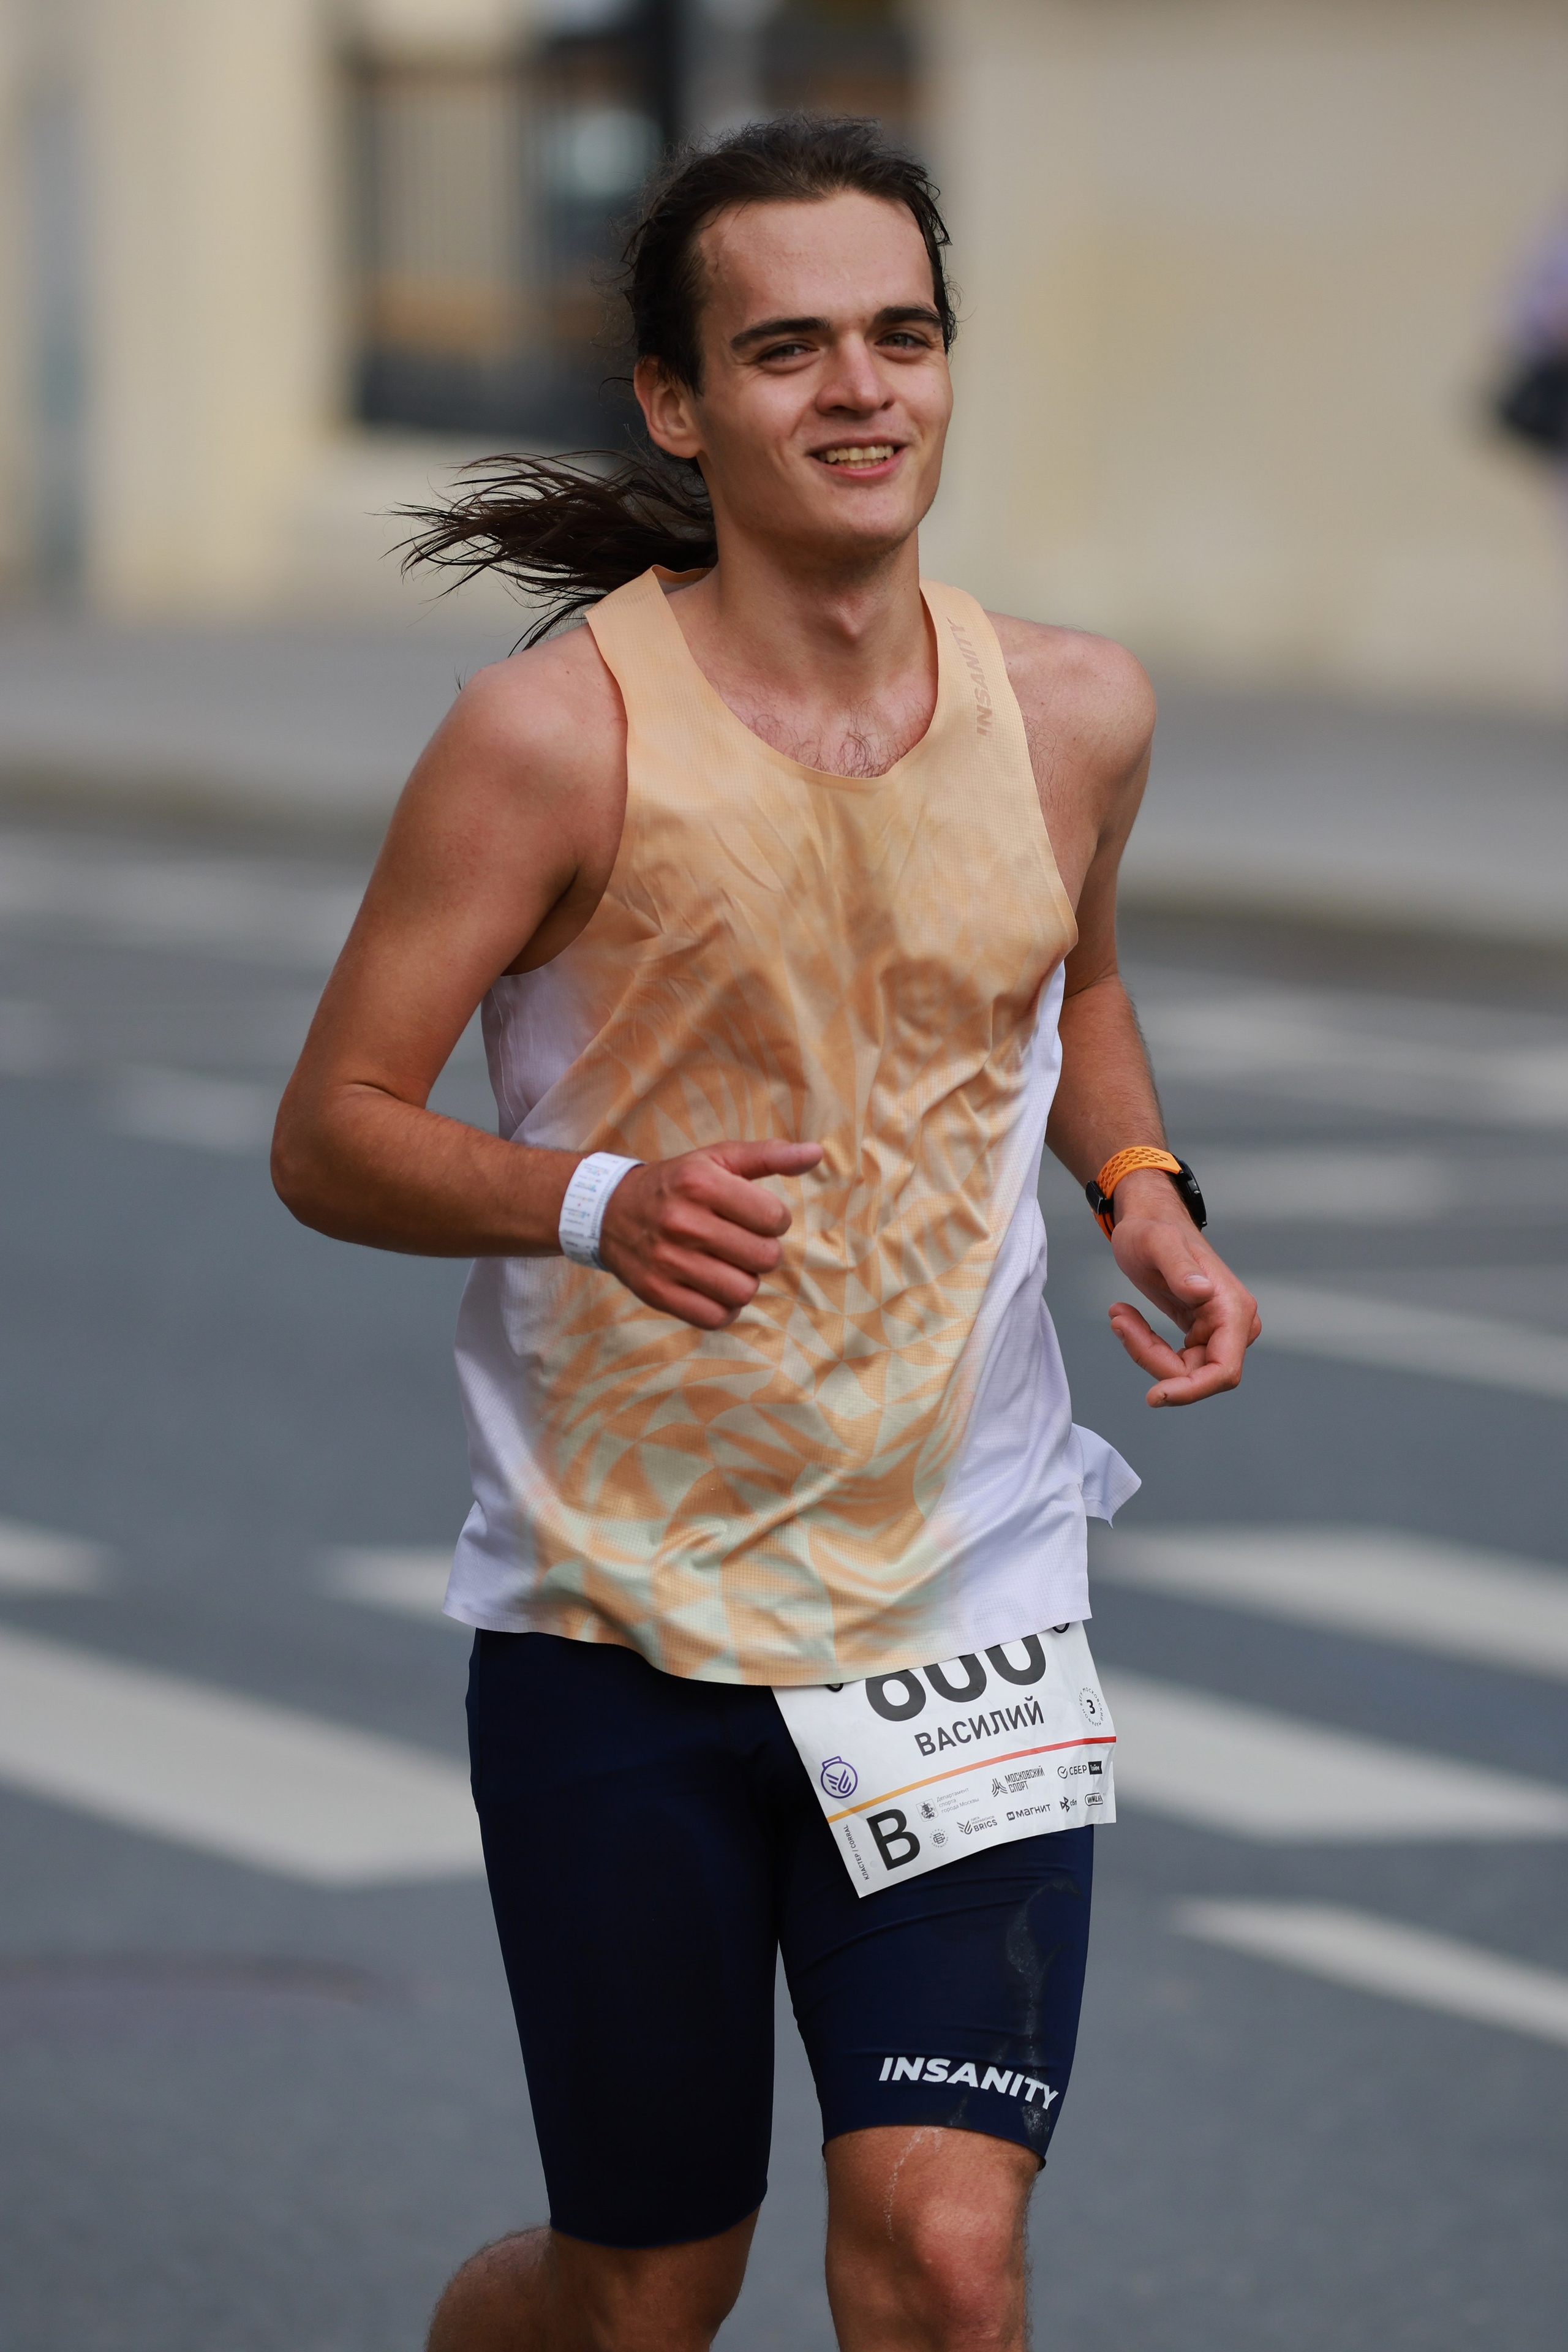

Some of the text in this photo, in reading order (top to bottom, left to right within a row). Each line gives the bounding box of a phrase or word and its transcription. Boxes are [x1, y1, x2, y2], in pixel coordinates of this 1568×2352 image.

[946, 617, 993, 736] INSANITY
[1086, 1699, 1096, 1714] 3
[914, 1695, 1044, 1756] ВАСИЛИЙ
[1005, 1765, 1045, 1784] МОСКОВСКИЙ
[1069, 1765, 1087, 1776] СБЕР
[937, 1787, 969, 1802] Департамент
[1008, 1781, 1029, 1793] СПОРТ
[938, 1798, 957, 1809] спорта
[941, 1798, 979, 1814] города Москвы
[973, 1819, 998, 1832] BRICS
[843, 1824, 856, 1849] CORRAL
[854, 1853, 870, 1880] КЛАСТЕР
[879, 2057, 1058, 2109] INSANITY
